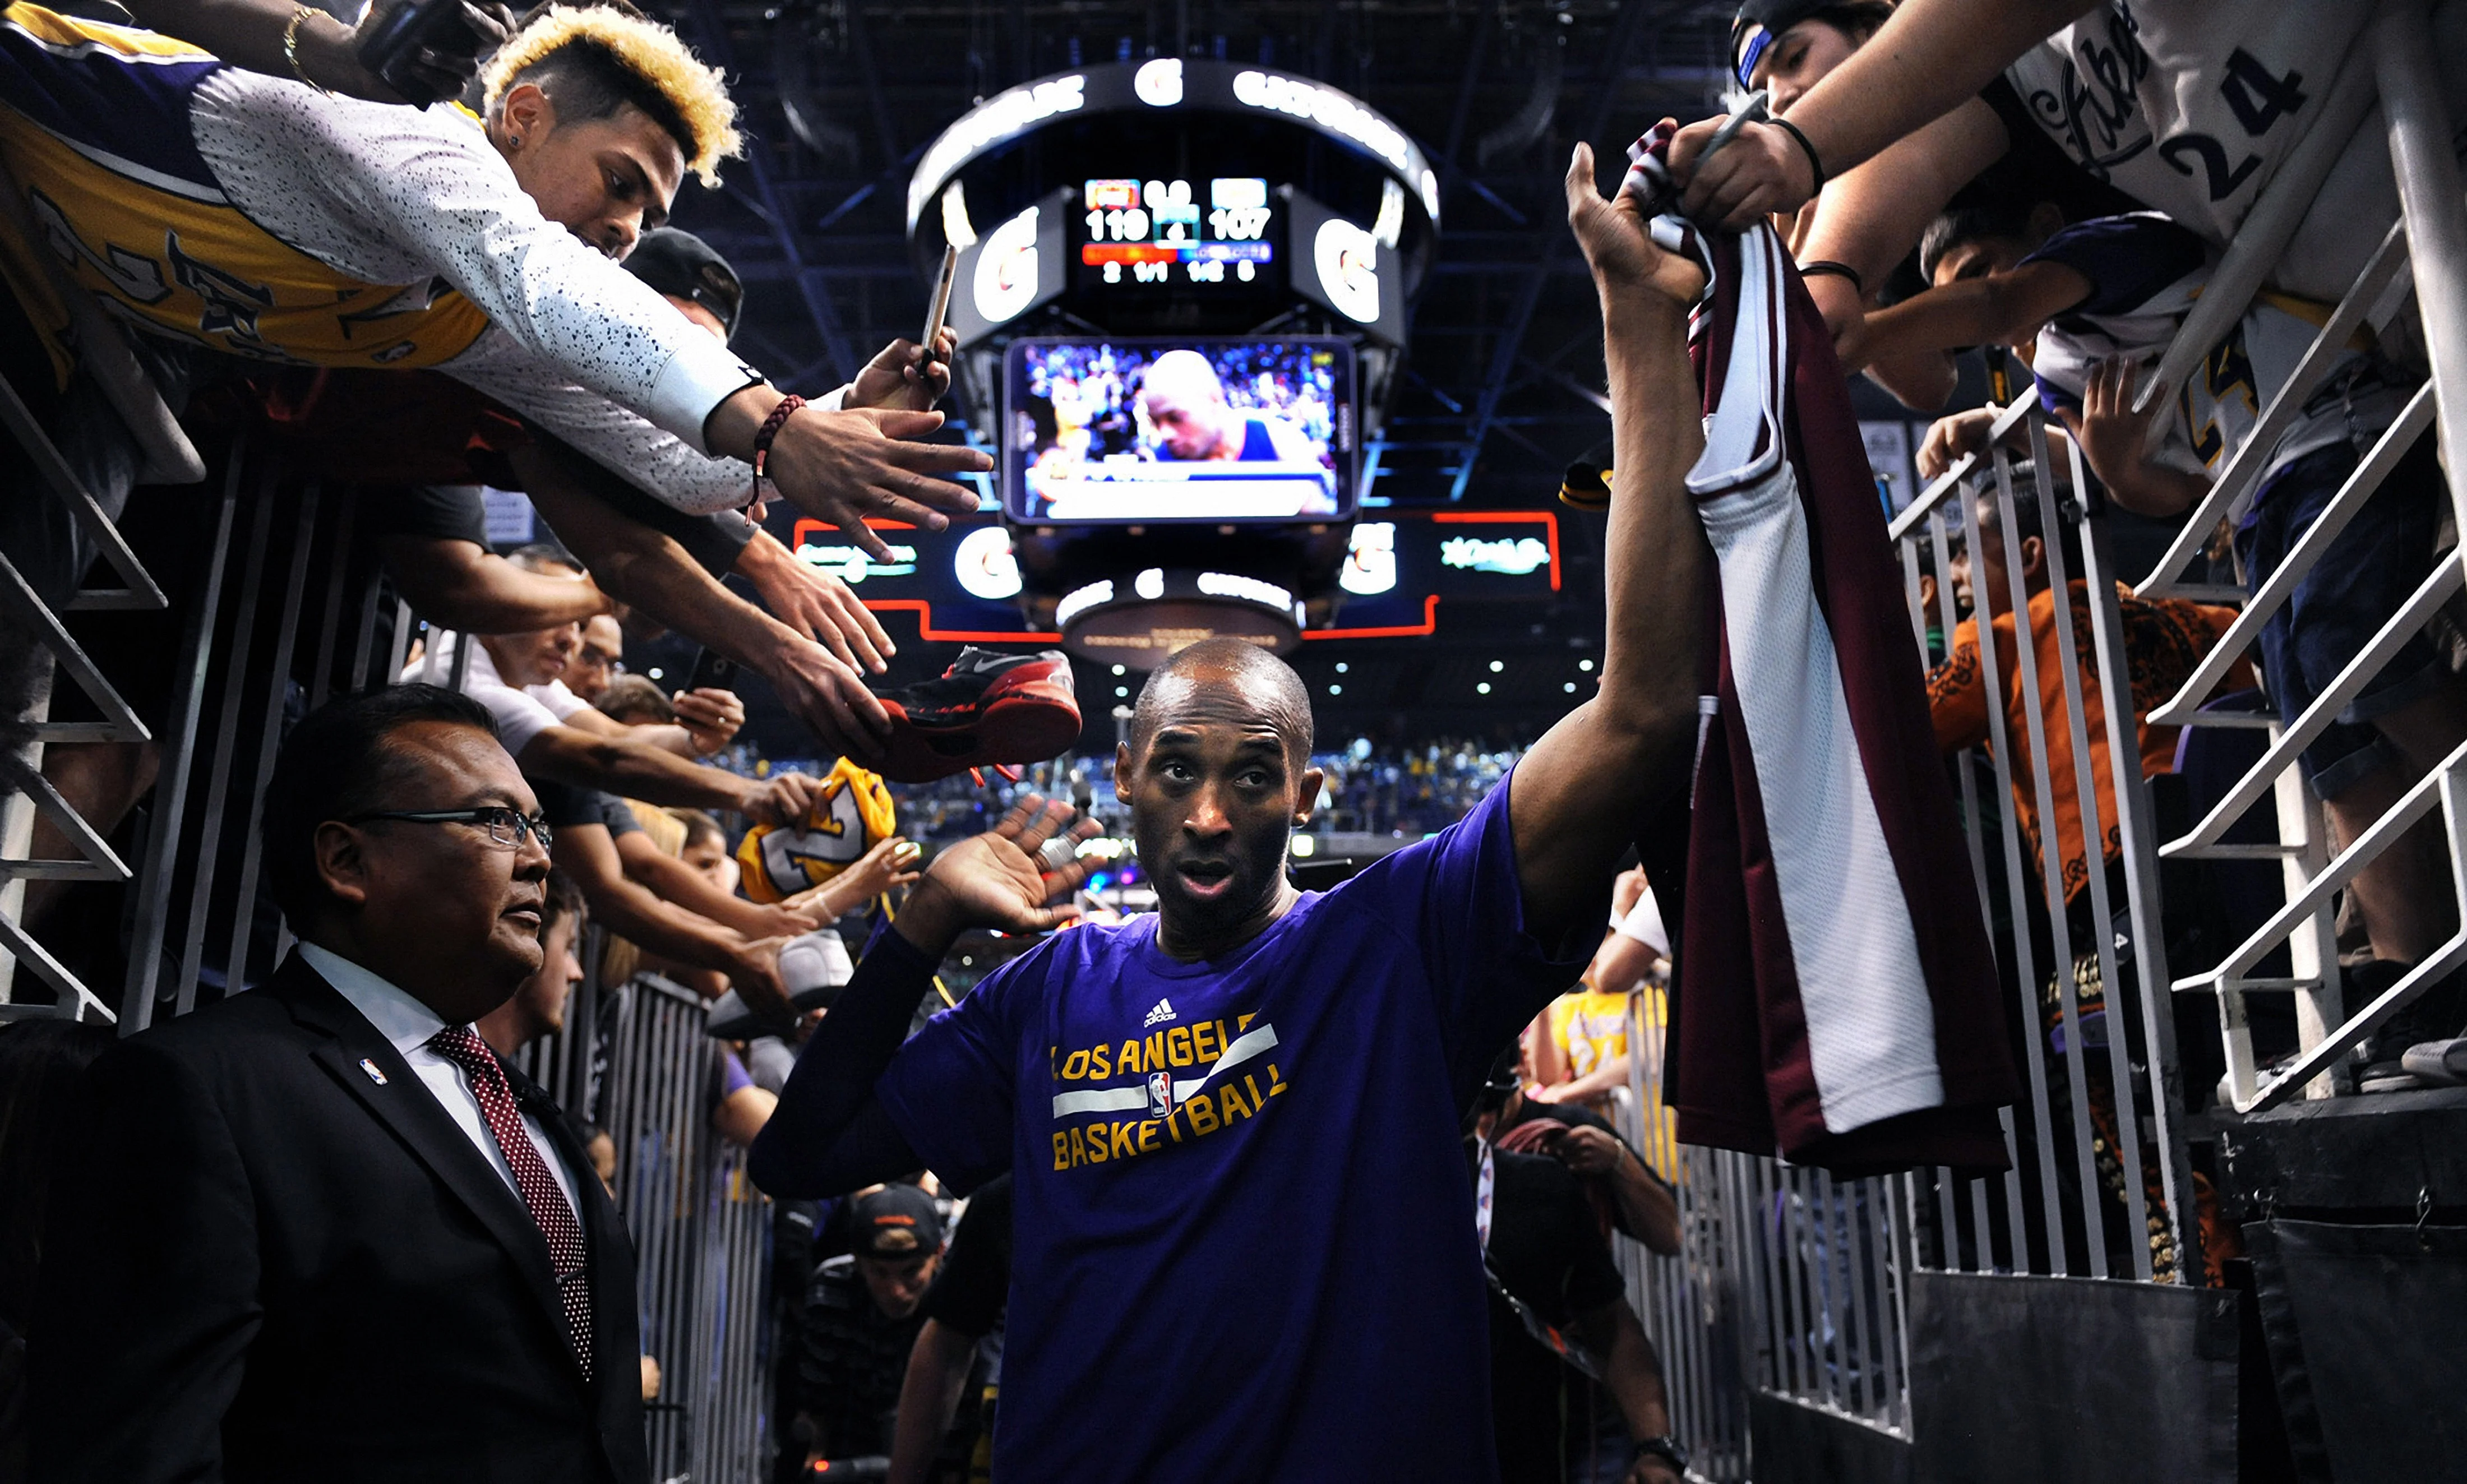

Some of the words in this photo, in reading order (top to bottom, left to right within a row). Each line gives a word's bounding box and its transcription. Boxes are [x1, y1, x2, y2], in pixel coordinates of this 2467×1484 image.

[2159, 47, 2309, 202] 24
[1208, 207, 1271, 240] 107
[1117, 1009, 1261, 1075] ANGEL
[1144, 1013, 1177, 1028] adidas
[1053, 1064, 1288, 1171] BASKETBALL
